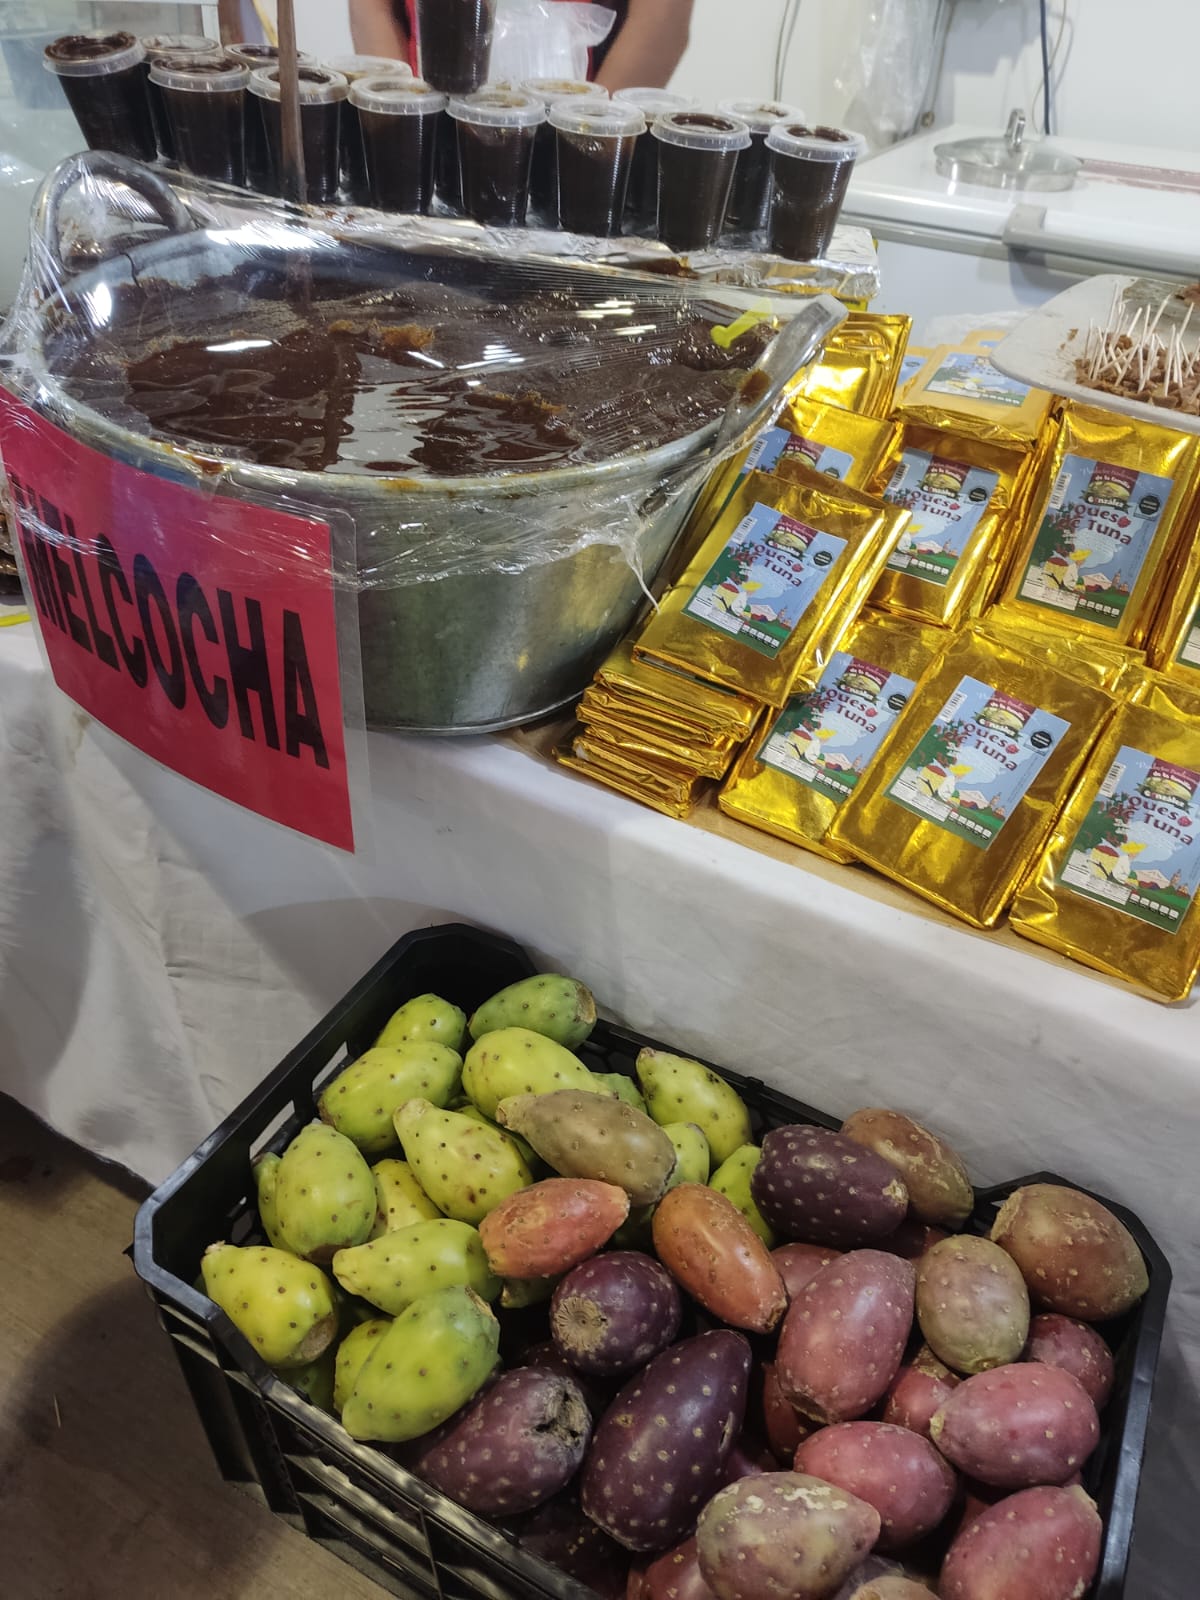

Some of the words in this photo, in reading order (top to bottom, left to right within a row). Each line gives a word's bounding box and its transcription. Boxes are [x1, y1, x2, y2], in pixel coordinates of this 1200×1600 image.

[922, 503, 962, 522] Tuna
[1088, 519, 1132, 545] Tuna
[763, 558, 802, 587] Tuna
[8, 472, 330, 770] MELCOCHA
[836, 704, 877, 734] Tuna
[974, 739, 1018, 771] Tuna
[1143, 812, 1194, 846] Tuna
